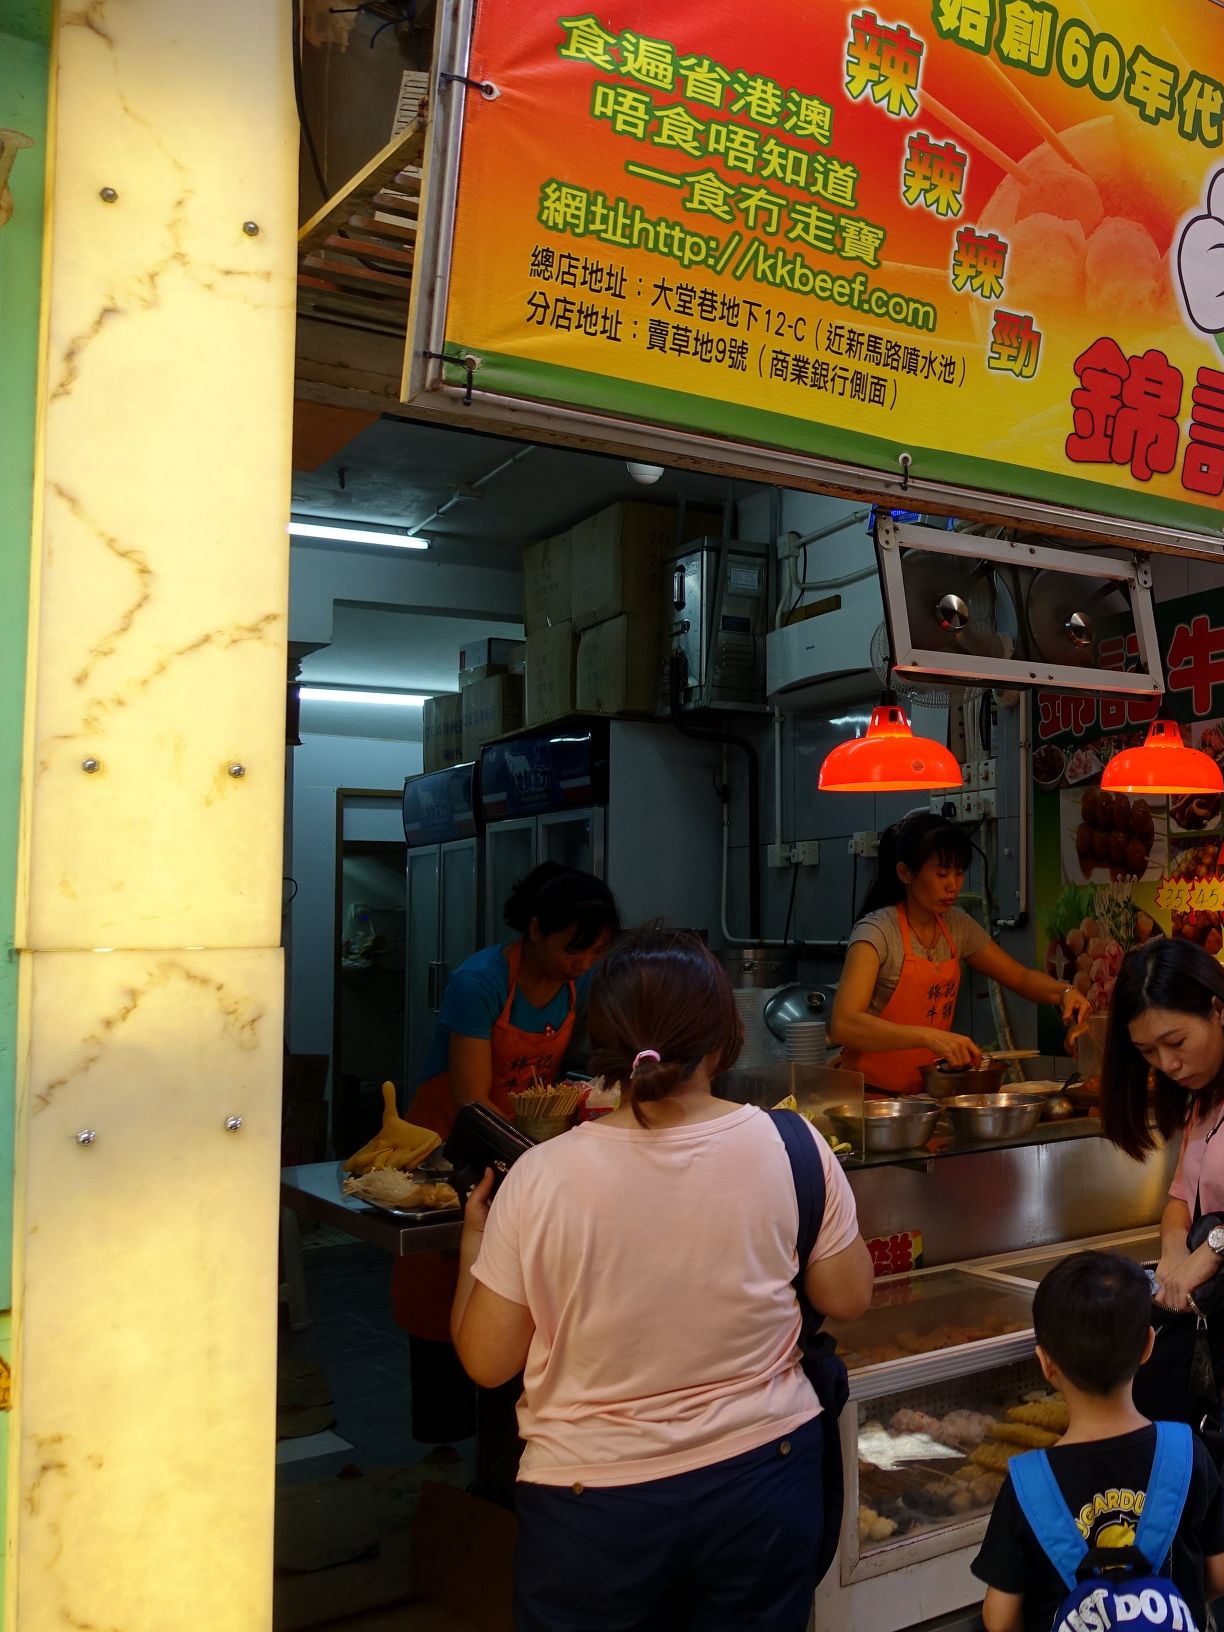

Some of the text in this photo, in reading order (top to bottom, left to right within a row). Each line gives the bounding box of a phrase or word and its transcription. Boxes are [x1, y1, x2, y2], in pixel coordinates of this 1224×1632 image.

[559, 15, 834, 145] 食遍省港澳
[594, 82, 858, 208] 唔食唔知道
[627, 155, 884, 268] 一食冇走寶
[1195, 888, 1219, 909] 45
[1112, 1588, 1168, 1625] DO
